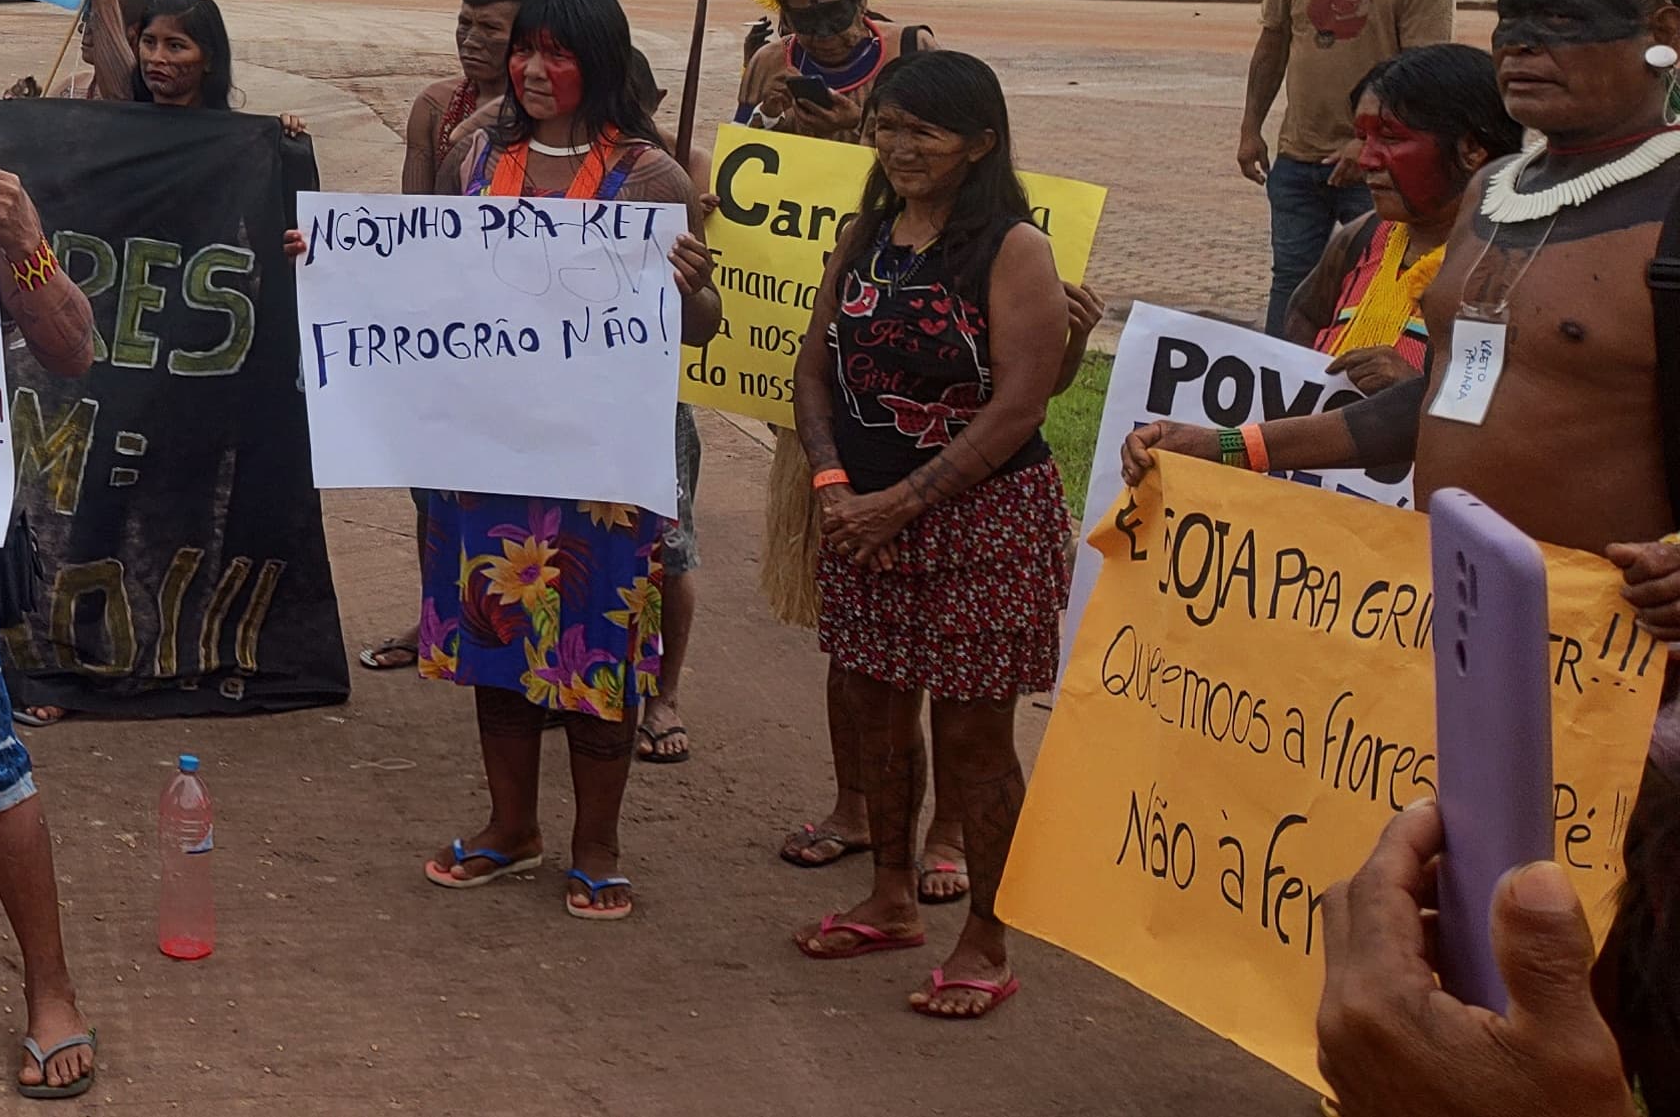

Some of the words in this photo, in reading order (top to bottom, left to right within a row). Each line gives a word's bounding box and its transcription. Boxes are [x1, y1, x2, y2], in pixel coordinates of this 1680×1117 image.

[581, 202, 669, 245] KET
[716, 143, 857, 269] Car
[686, 343, 727, 387] do
[738, 370, 795, 404] noss
[1267, 547, 1341, 634] PRA
[1283, 707, 1306, 769] a
[1116, 780, 1196, 891] Não
[1219, 808, 1245, 915] à
